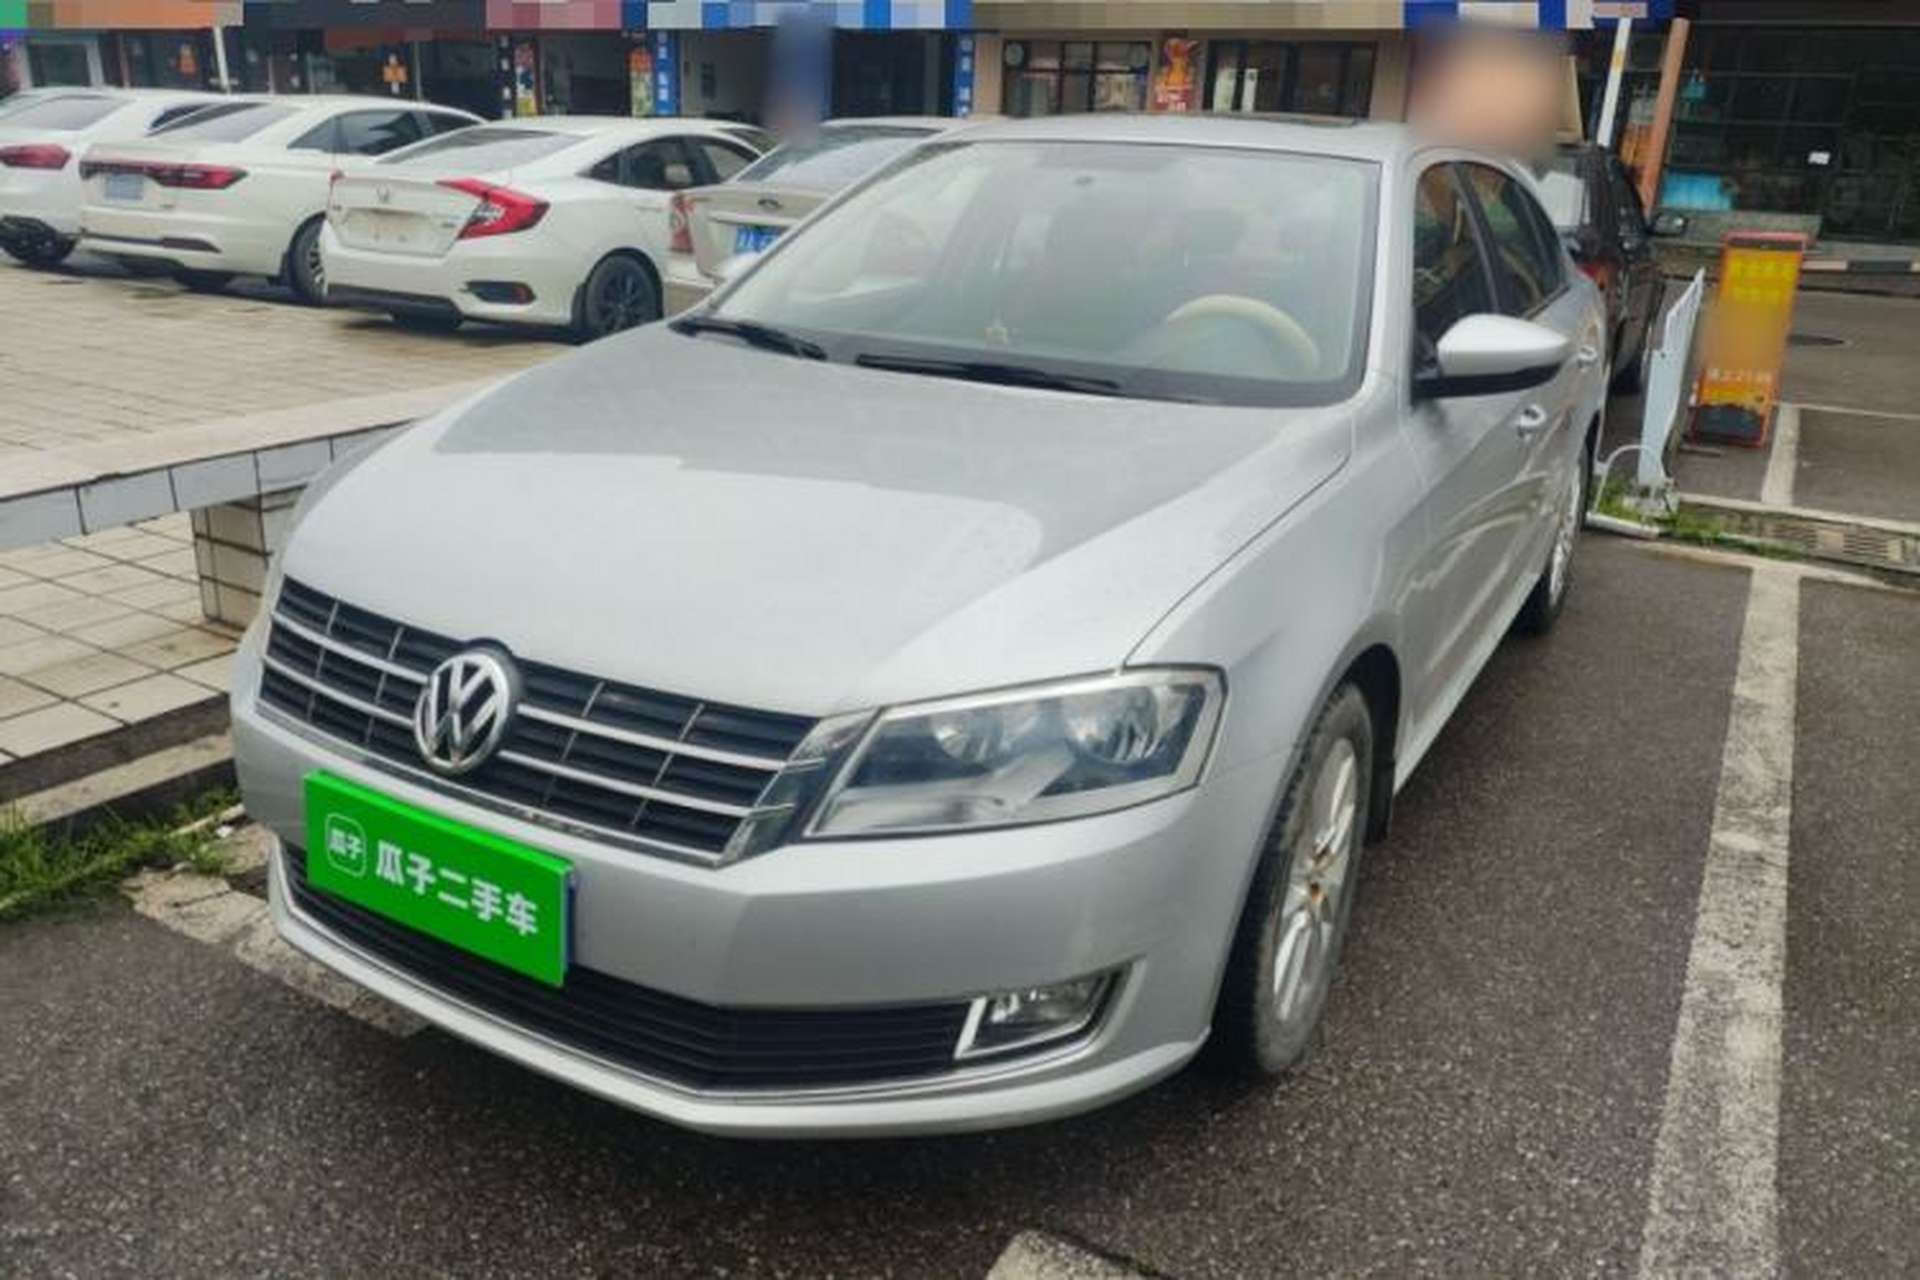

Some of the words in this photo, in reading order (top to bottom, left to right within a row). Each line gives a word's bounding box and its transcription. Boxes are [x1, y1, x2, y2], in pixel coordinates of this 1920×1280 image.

[377, 842, 538, 936] 瓜子二手车
